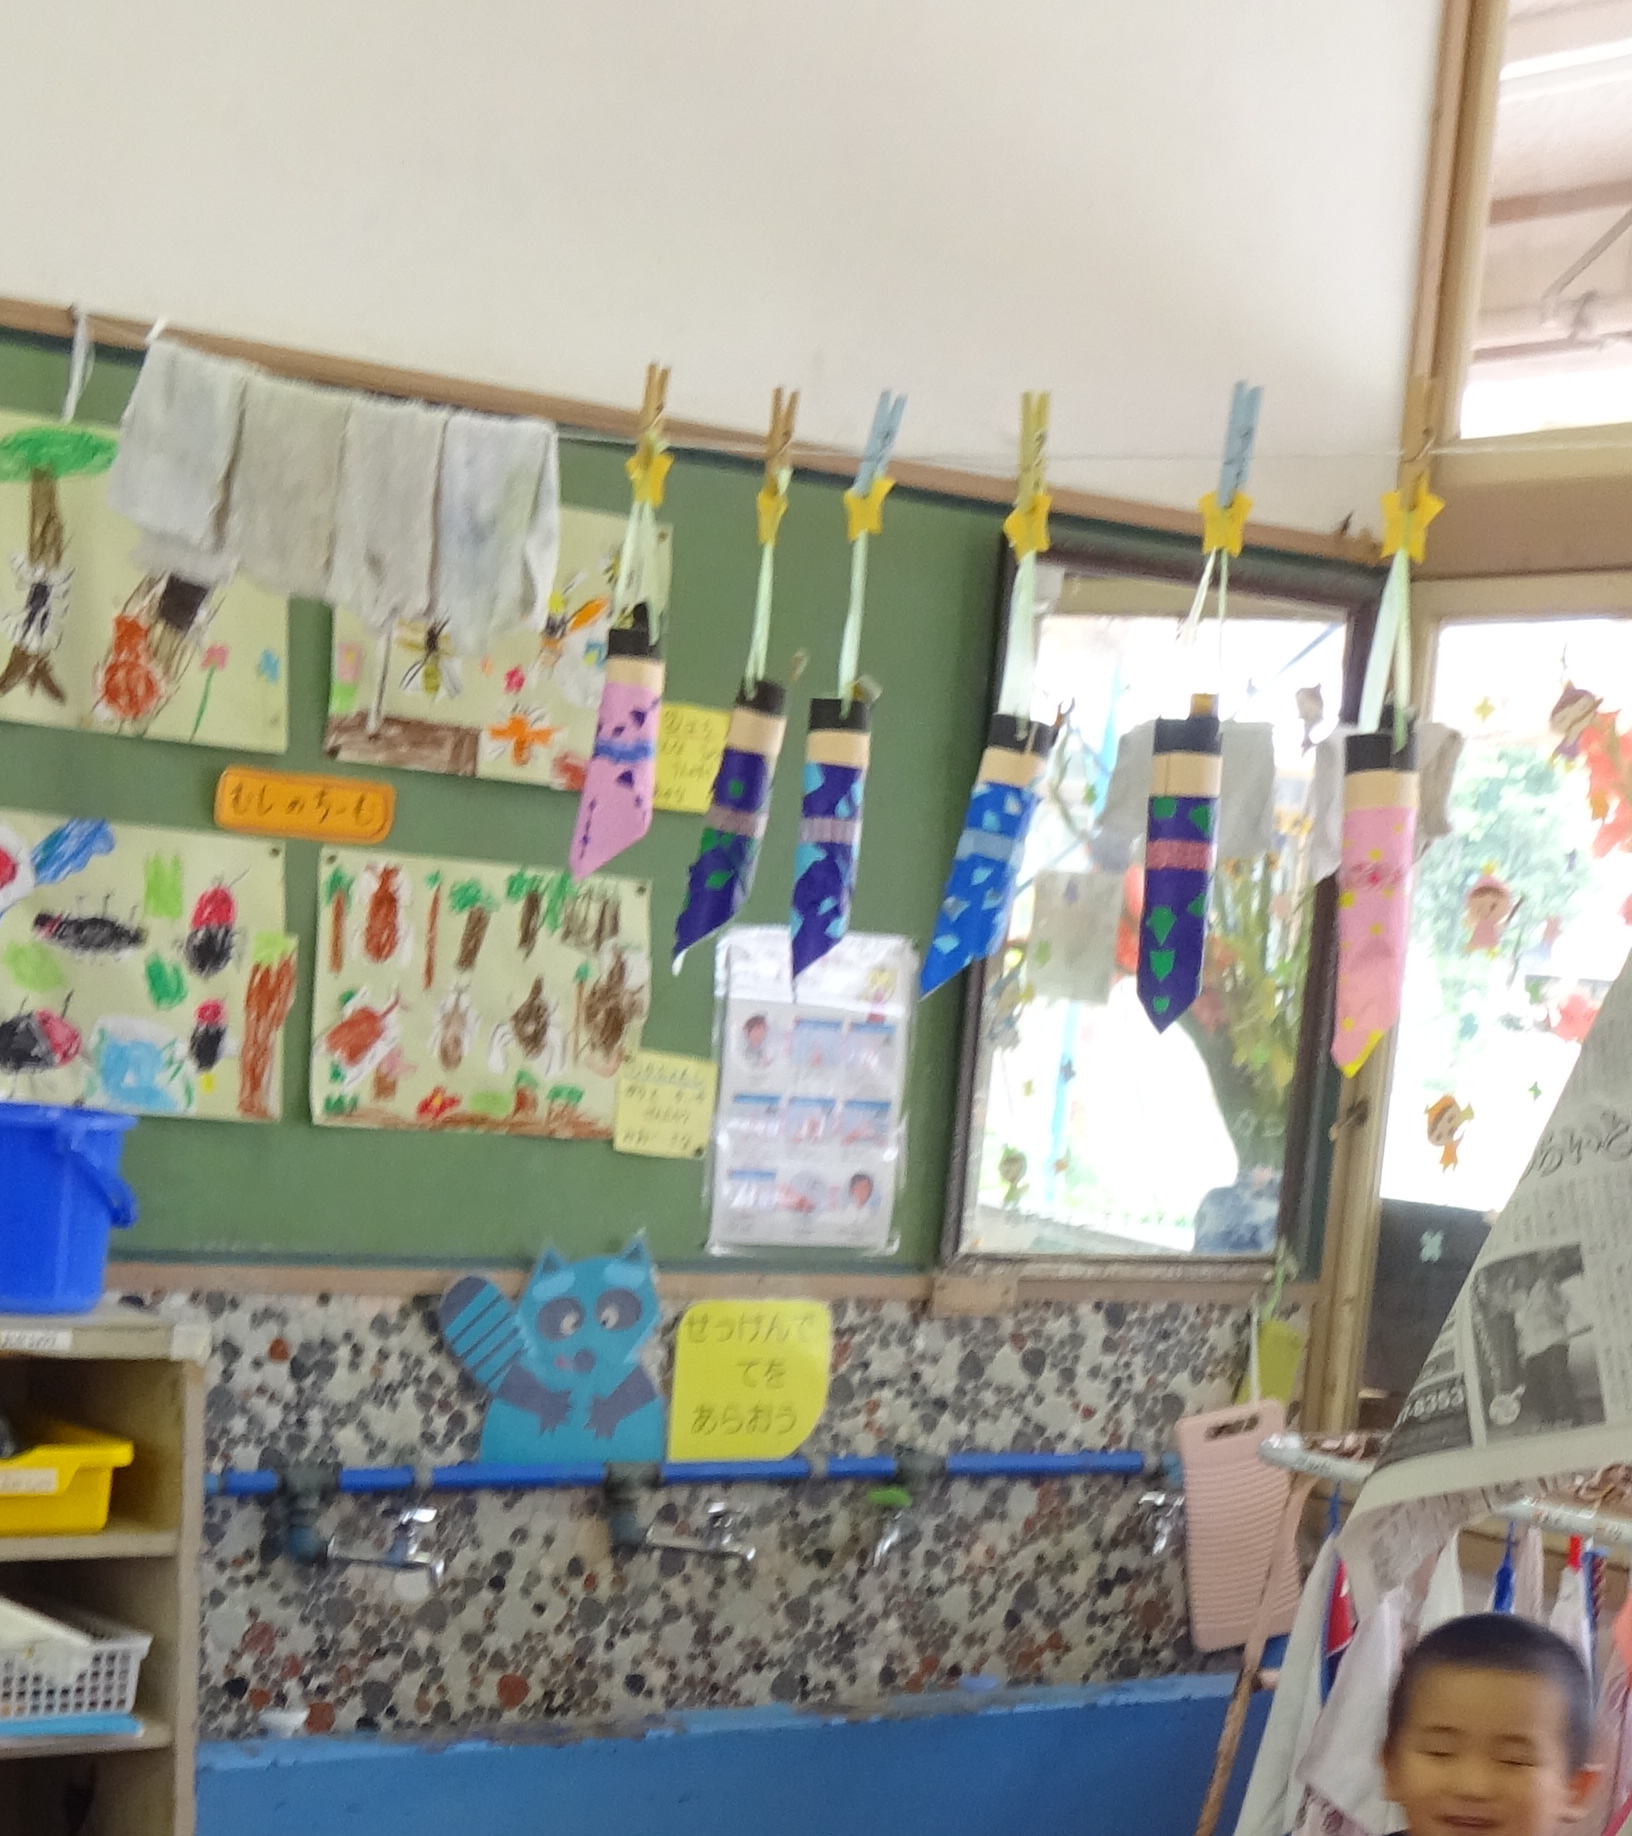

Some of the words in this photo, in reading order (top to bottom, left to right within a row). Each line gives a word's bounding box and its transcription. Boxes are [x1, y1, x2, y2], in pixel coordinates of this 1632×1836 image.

[737, 1357, 788, 1391] てを
[689, 1400, 799, 1436] あらおう
